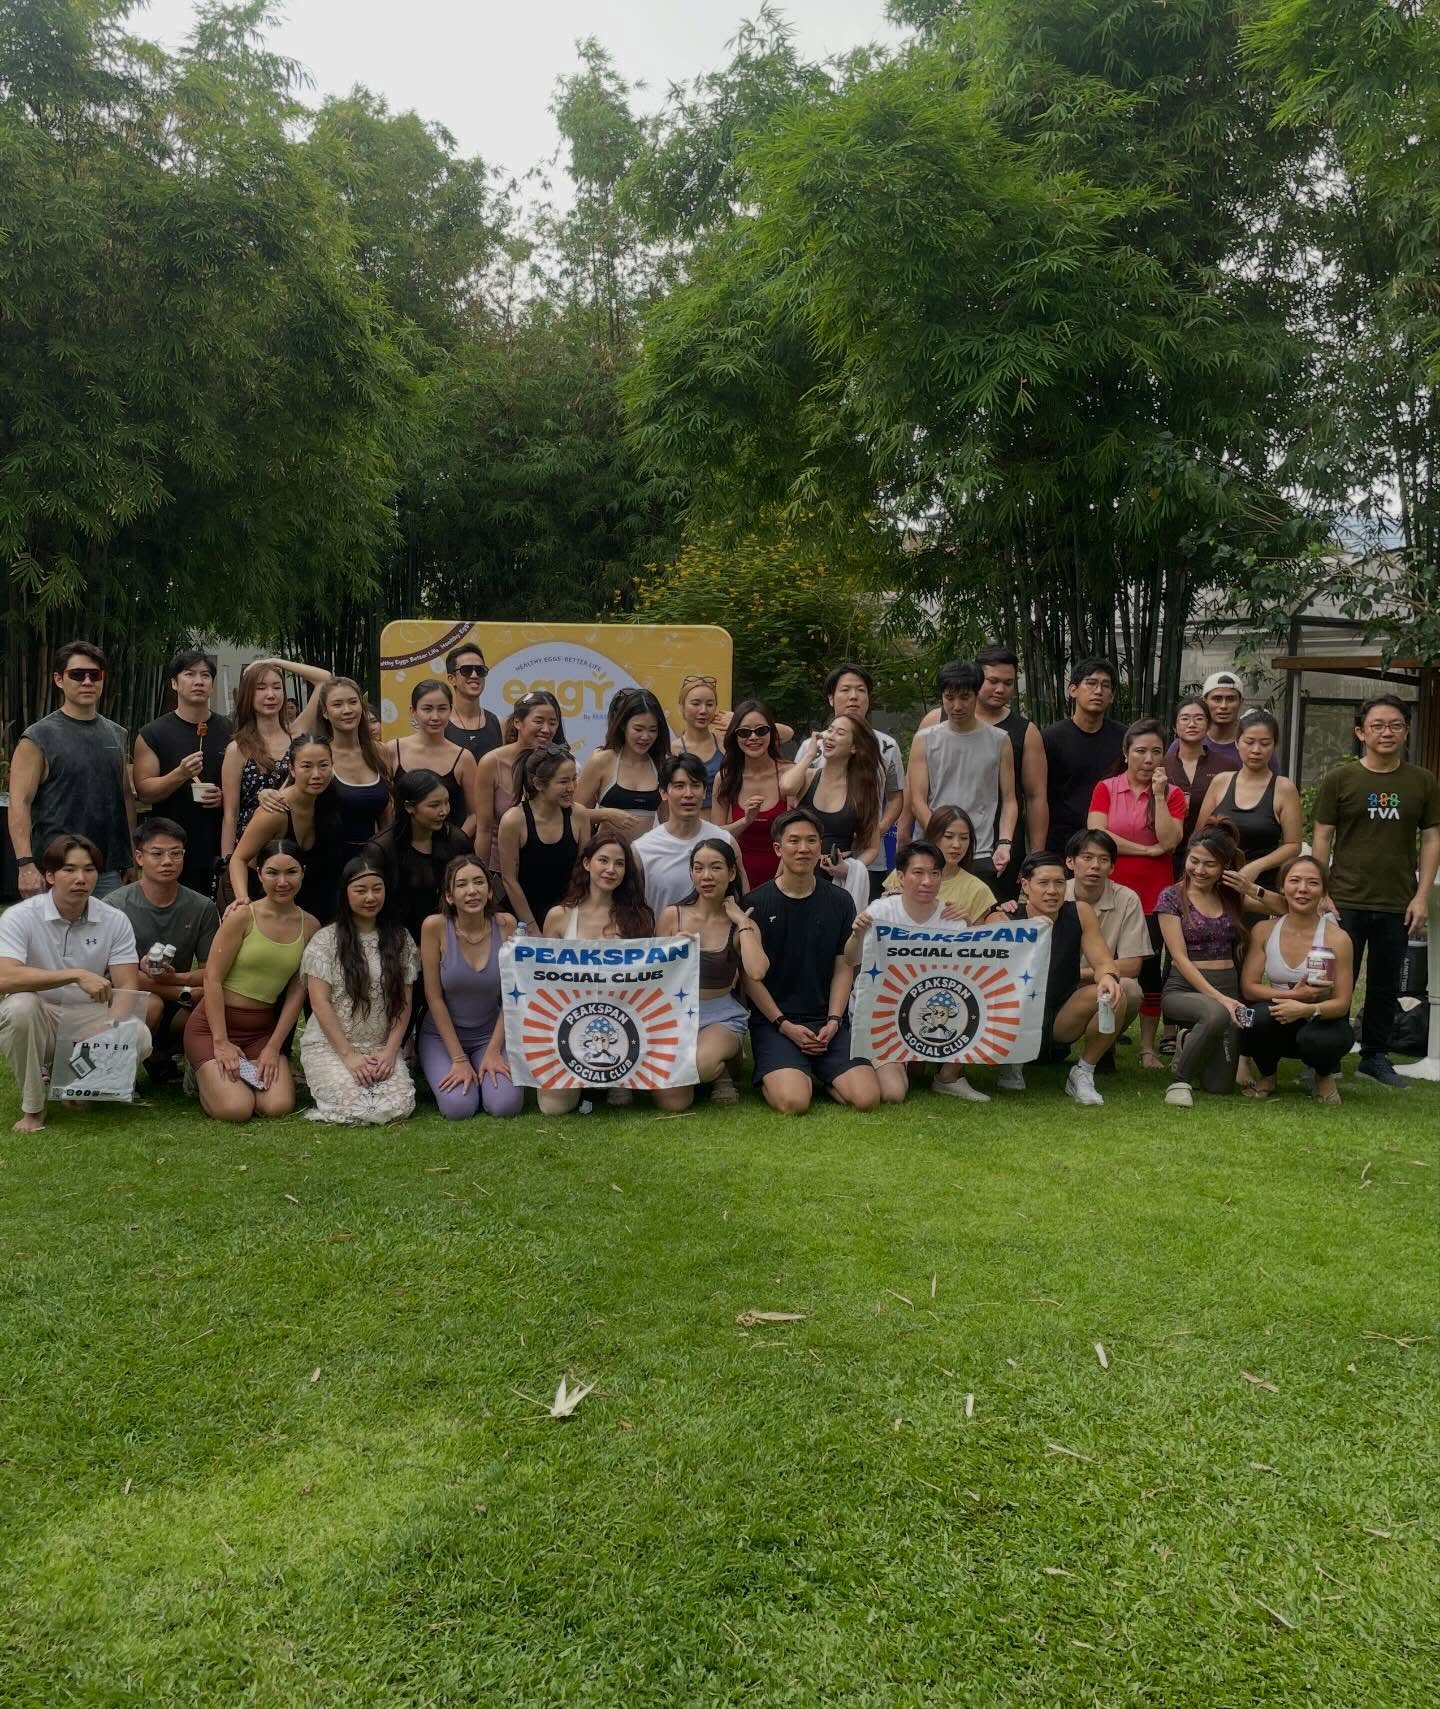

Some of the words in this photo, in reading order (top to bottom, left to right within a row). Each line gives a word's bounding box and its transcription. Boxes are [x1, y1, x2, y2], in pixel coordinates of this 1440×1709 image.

[409, 653, 428, 663] Better
[428, 648, 439, 656] Life
[514, 657, 542, 672] HEALTHY
[564, 656, 588, 666] BETTER
[589, 662, 602, 673] LIFE
[1367, 807, 1400, 820] TVA
[876, 925, 1038, 943] PEAKSPAN
[514, 944, 689, 966] PEAKSPAN
[886, 947, 953, 958] SOCIAL
[957, 948, 1010, 959] CLUB
[533, 970, 607, 983] SOCIAL
[611, 969, 664, 983] CLUB
[909, 977, 972, 1000] PEAKSPAN
[565, 1004, 629, 1026] PEAKSPAN
[904, 1031, 941, 1057] SOCIAL
[942, 1033, 970, 1056] CLUB
[567, 1058, 608, 1082] SOCIAL
[609, 1058, 634, 1081] CLUB
